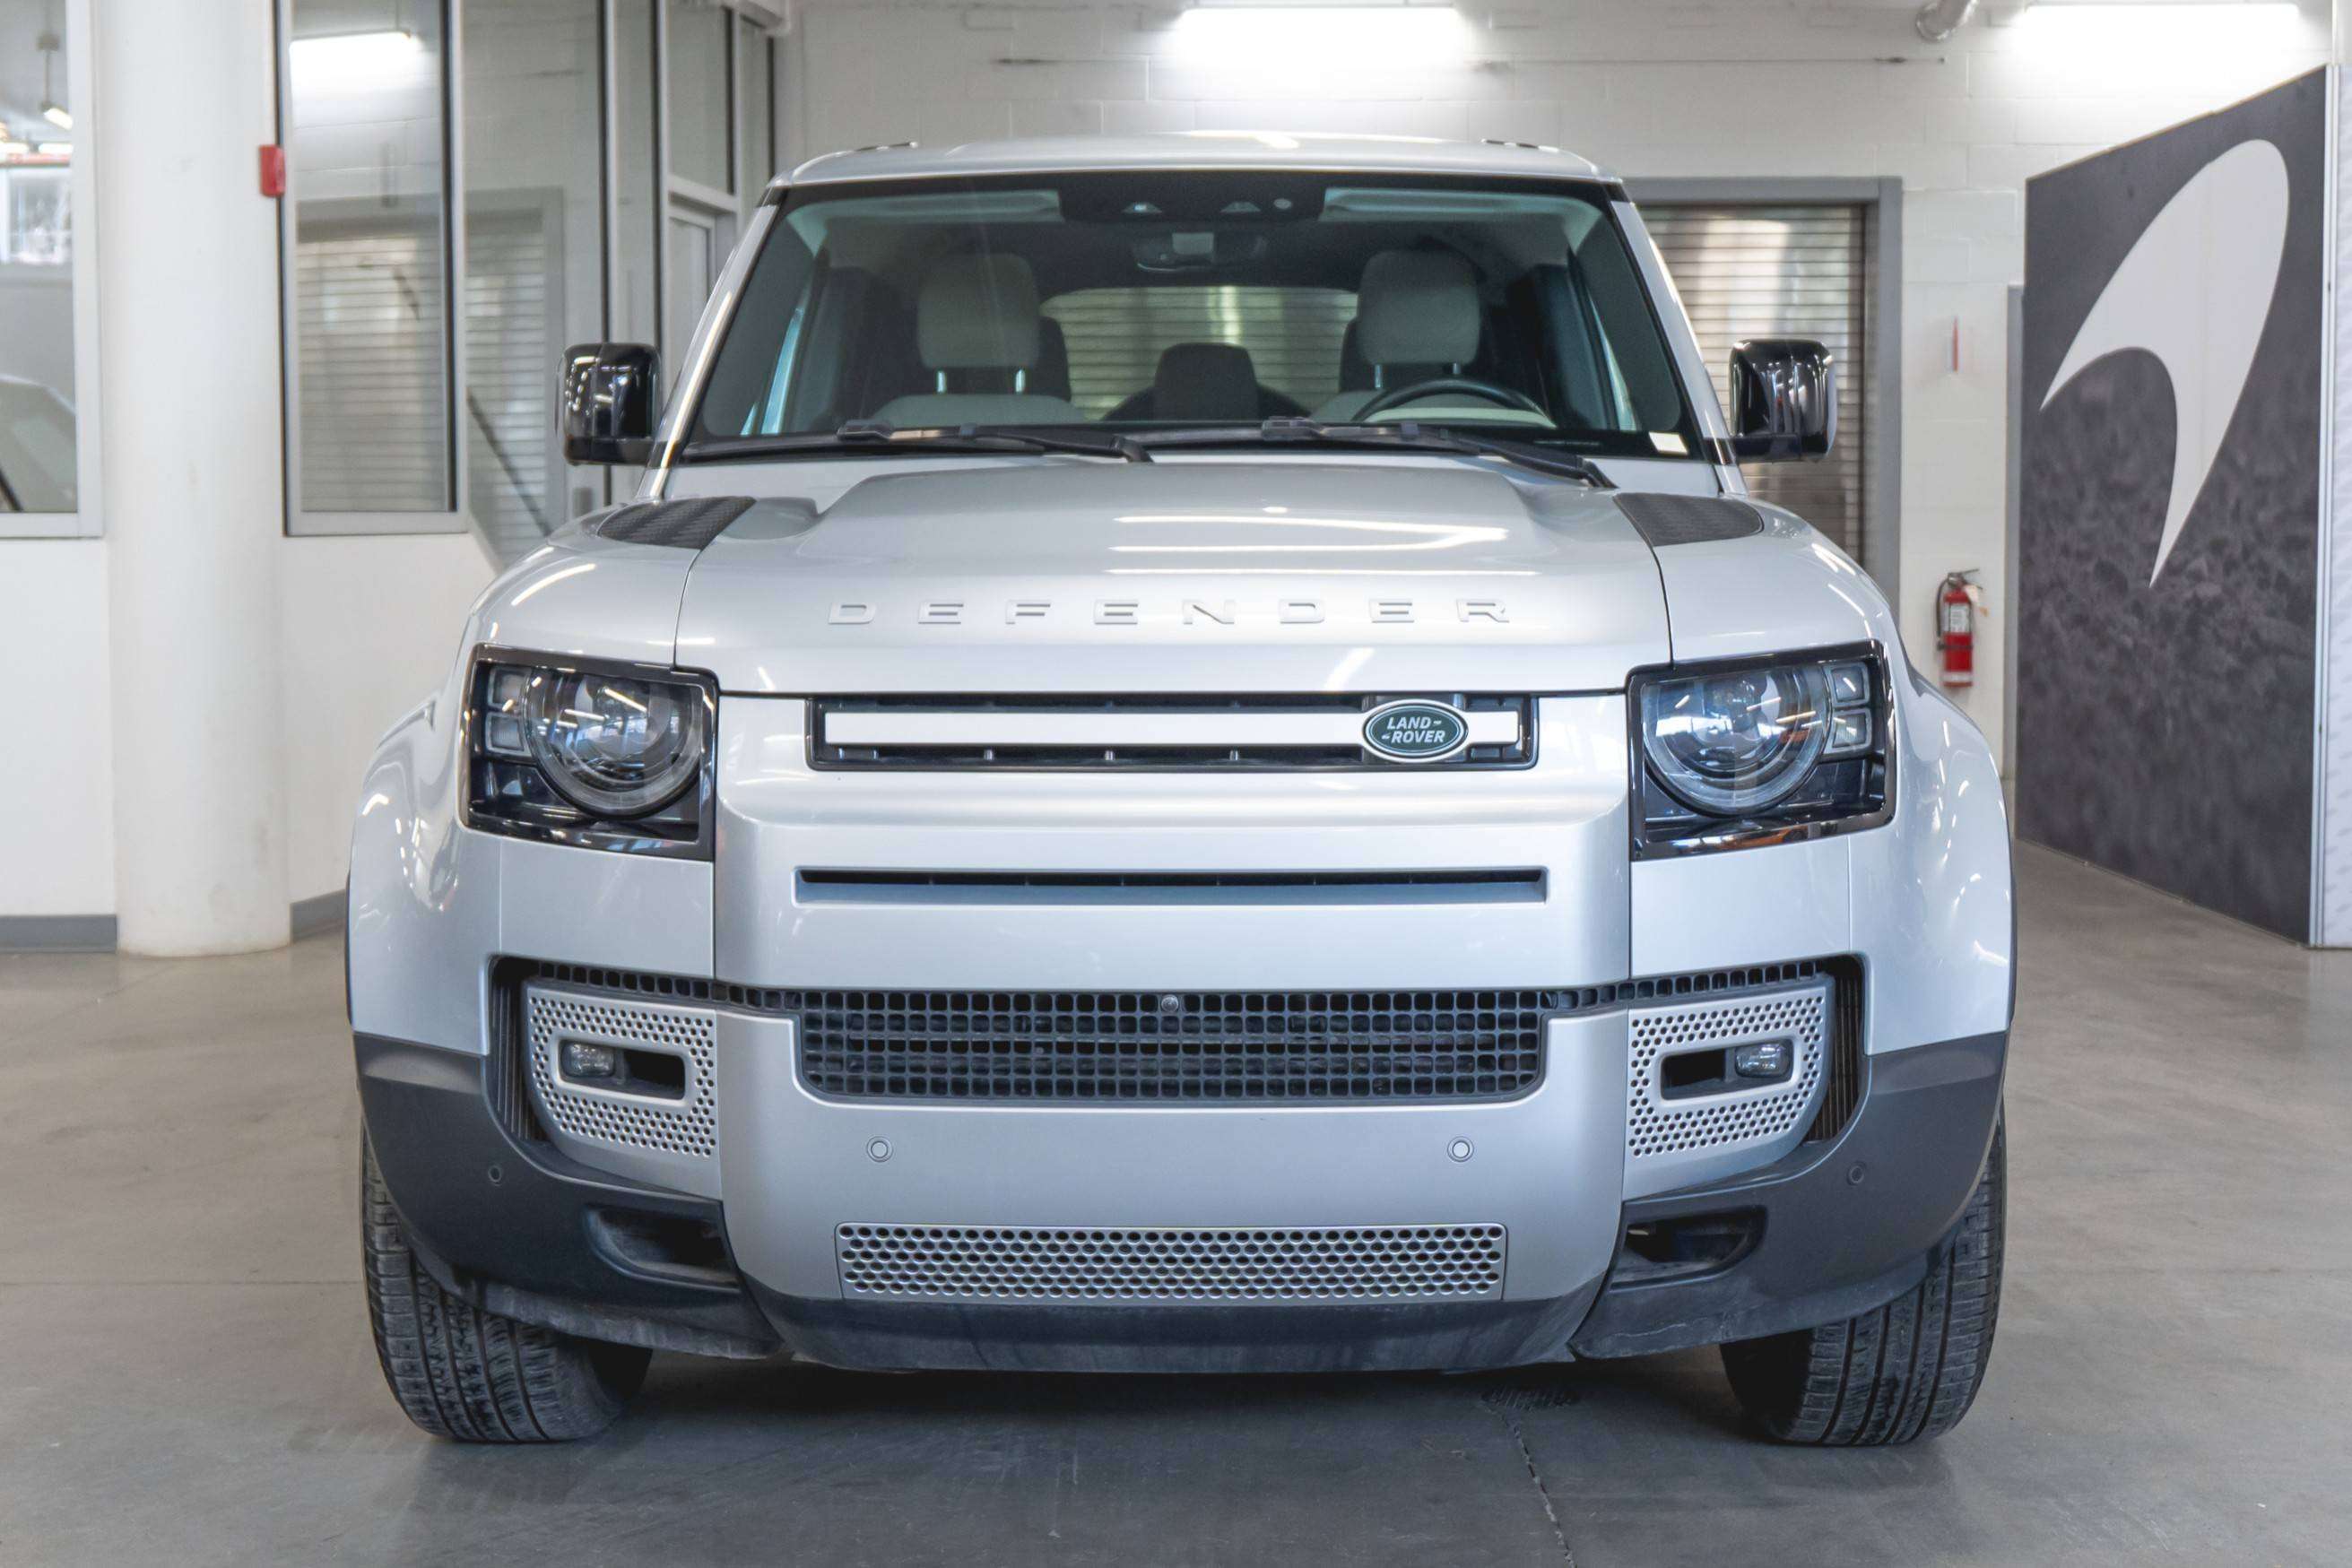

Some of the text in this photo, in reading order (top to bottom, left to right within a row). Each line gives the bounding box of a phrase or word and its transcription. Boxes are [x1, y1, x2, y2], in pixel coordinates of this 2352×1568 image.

[828, 598, 1510, 625] DEFENDER
[1386, 716, 1431, 730] LAND
[1391, 731, 1445, 743] ROVER
